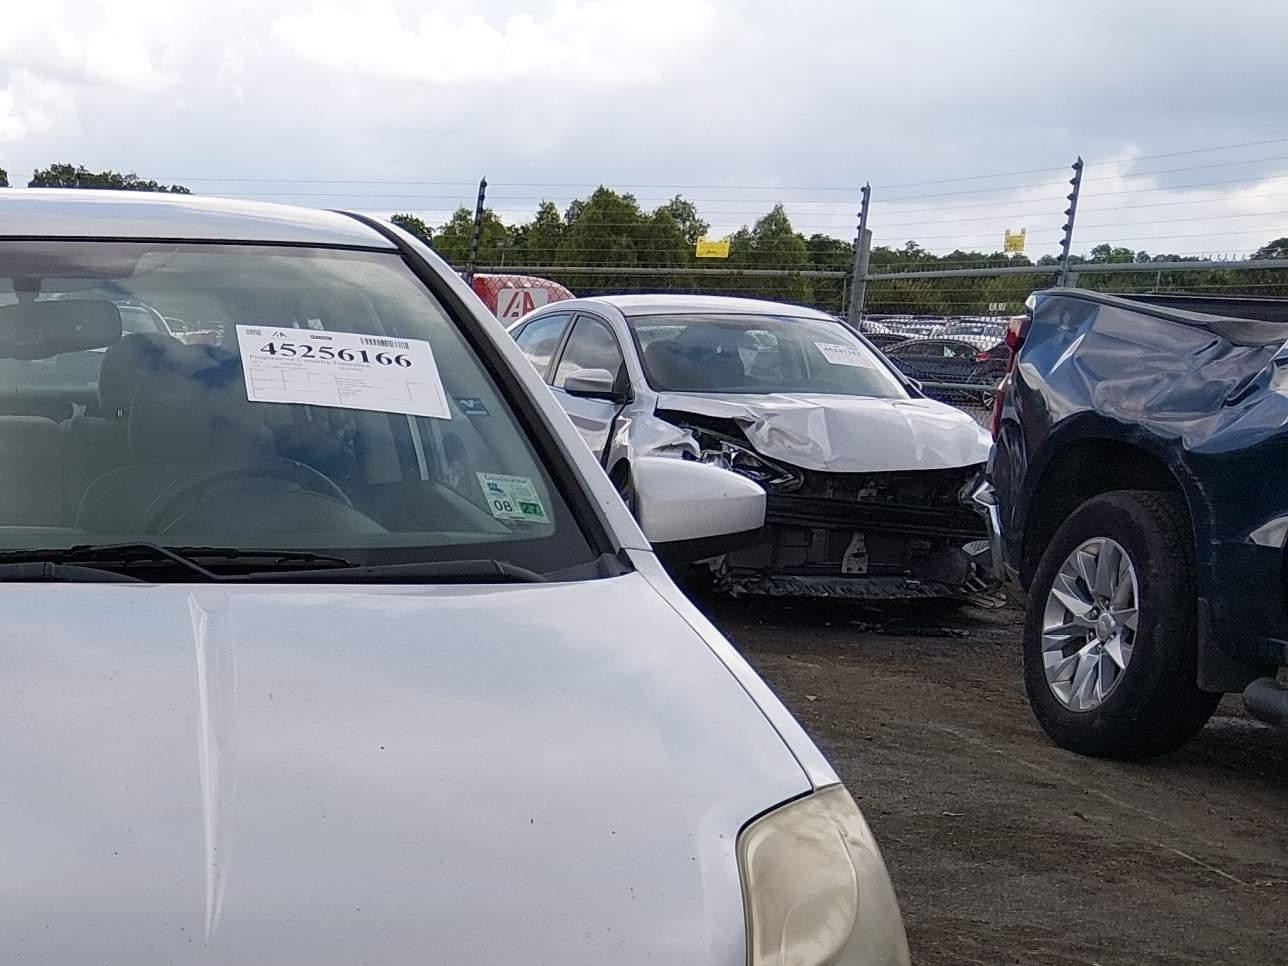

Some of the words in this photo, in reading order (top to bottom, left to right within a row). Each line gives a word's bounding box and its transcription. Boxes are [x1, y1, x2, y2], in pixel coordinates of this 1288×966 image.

[260, 342, 412, 368] 45256166
[493, 500, 512, 512] 08
[523, 503, 539, 514] 27
